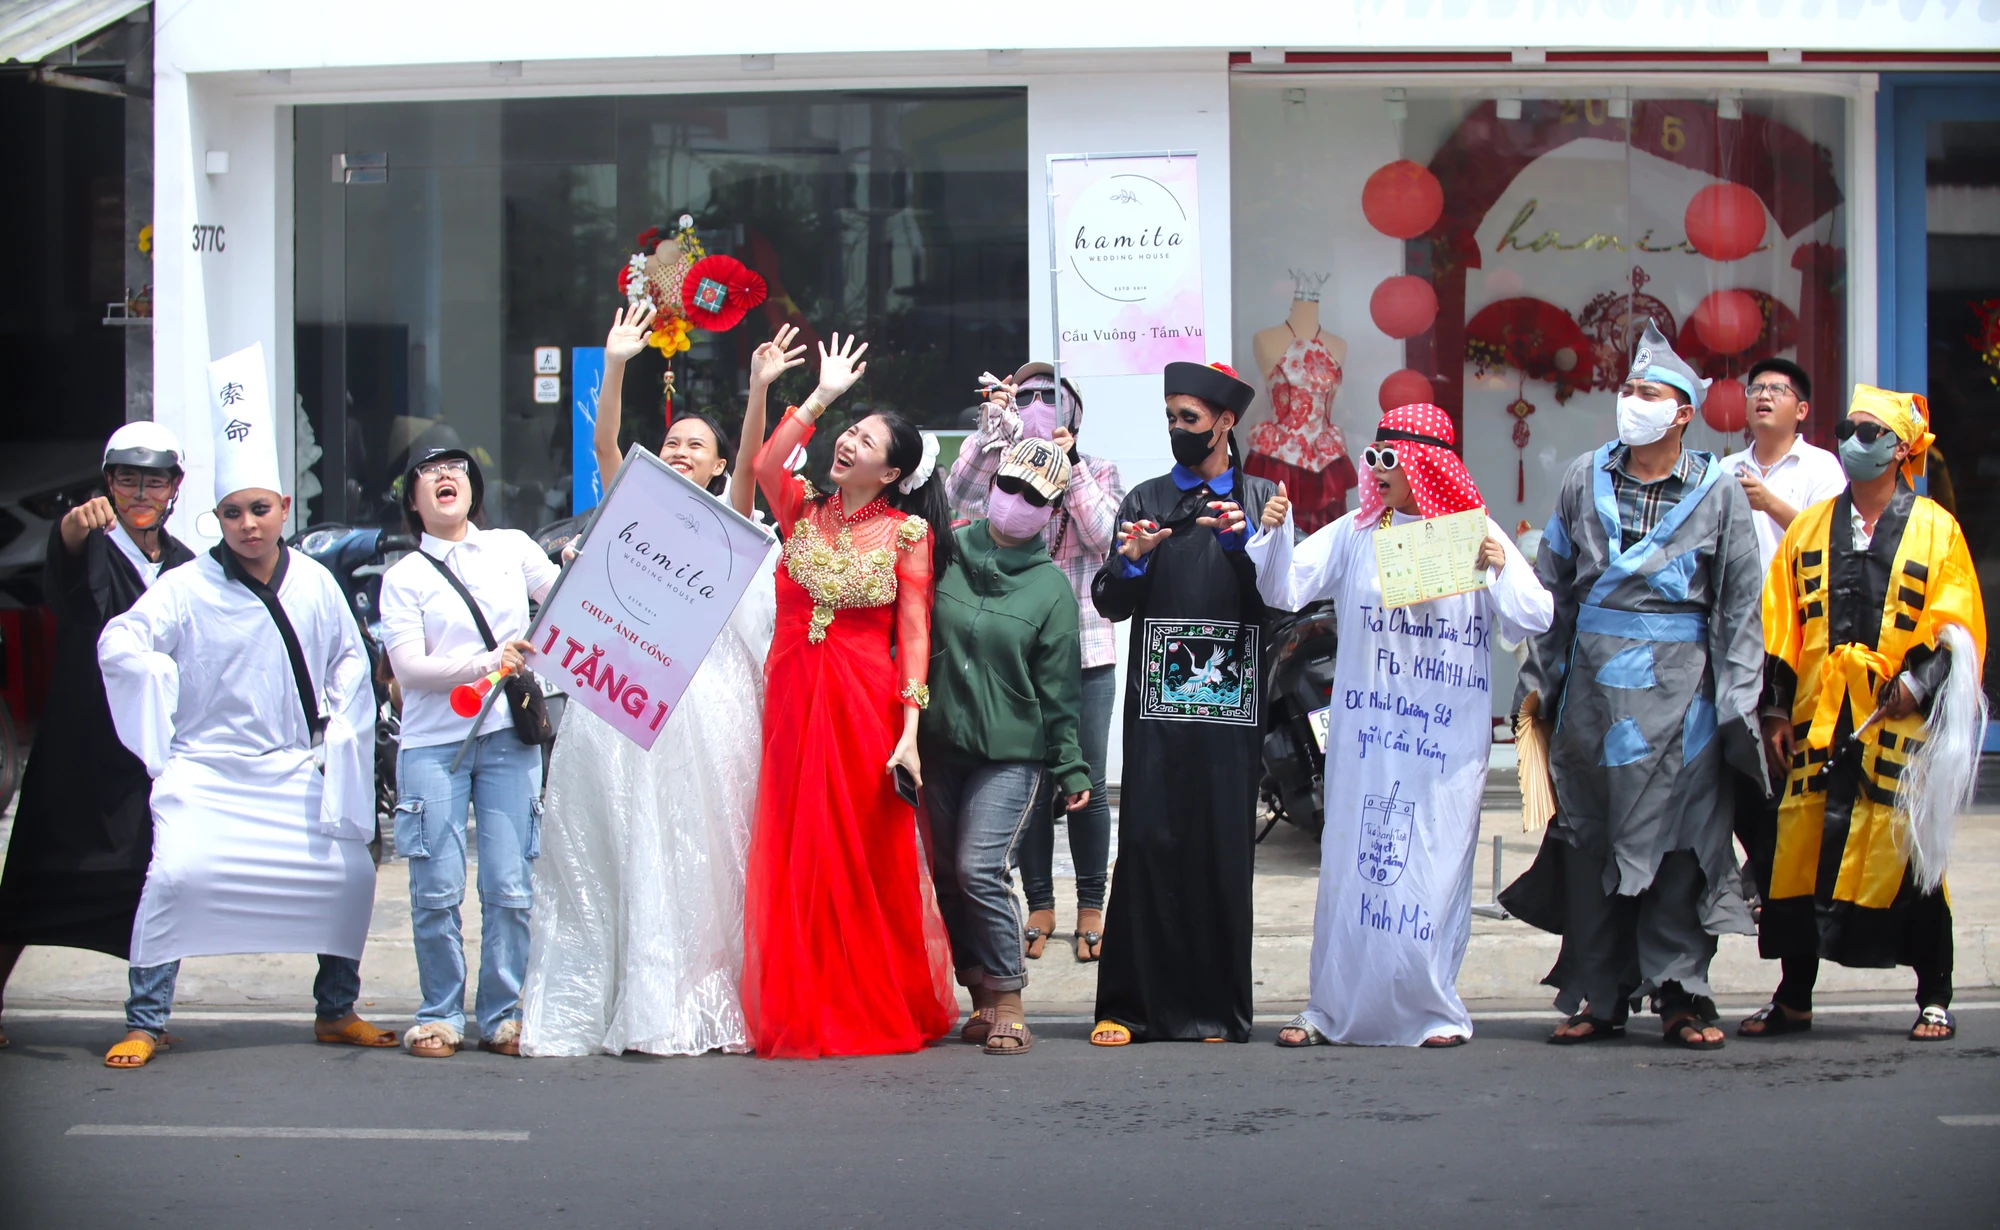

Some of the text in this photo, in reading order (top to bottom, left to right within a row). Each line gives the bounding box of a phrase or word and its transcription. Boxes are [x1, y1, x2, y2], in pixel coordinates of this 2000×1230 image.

[192, 225, 225, 252] 377C
[1075, 225, 1184, 250] hamita
[1088, 252, 1170, 262] WEDDING HOUSE
[1062, 328, 1088, 342] Cầu
[1093, 328, 1136, 342] Vuông
[1184, 325, 1203, 337] Vu
[219, 381, 253, 443] 索命
[618, 521, 715, 599] hamita
[623, 552, 695, 605] WEDDING HOUSE
[581, 600, 673, 667] CHỤP ẢNH CỔNG
[1360, 605, 1383, 633] Trà
[1389, 607, 1433, 639] Chanh
[541, 624, 669, 732] 1 TẶNG 1
[1413, 649, 1463, 688] KHÁNH
[1345, 689, 1364, 709] ĐC
[1369, 691, 1392, 711] Nail
[1384, 729, 1410, 753] Cầu
[1416, 737, 1447, 774] Vuông
[1360, 892, 1435, 942] Kính Mời
